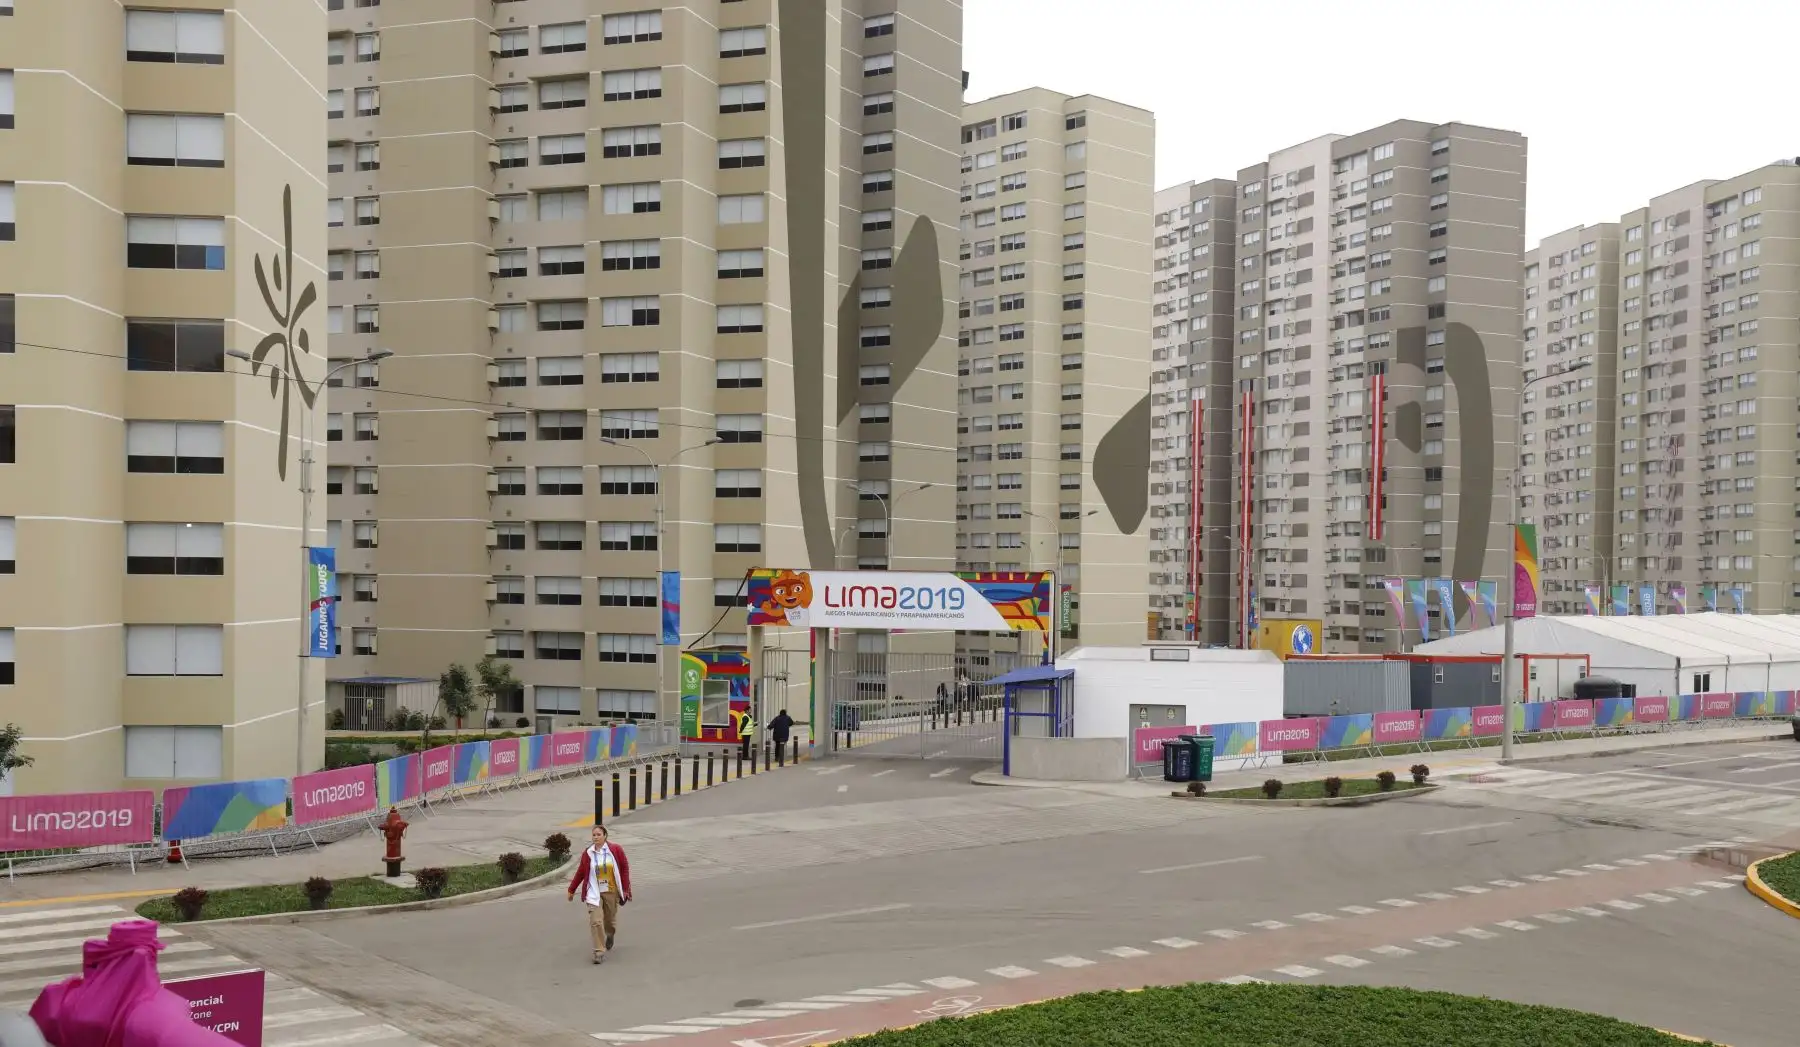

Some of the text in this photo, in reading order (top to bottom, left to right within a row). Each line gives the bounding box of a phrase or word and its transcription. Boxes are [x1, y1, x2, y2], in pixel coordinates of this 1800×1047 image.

[318, 563, 328, 650] JUGAMOS TODOS
[847, 610, 896, 618] PANAMERICANOS
[189, 994, 223, 1008] encial
